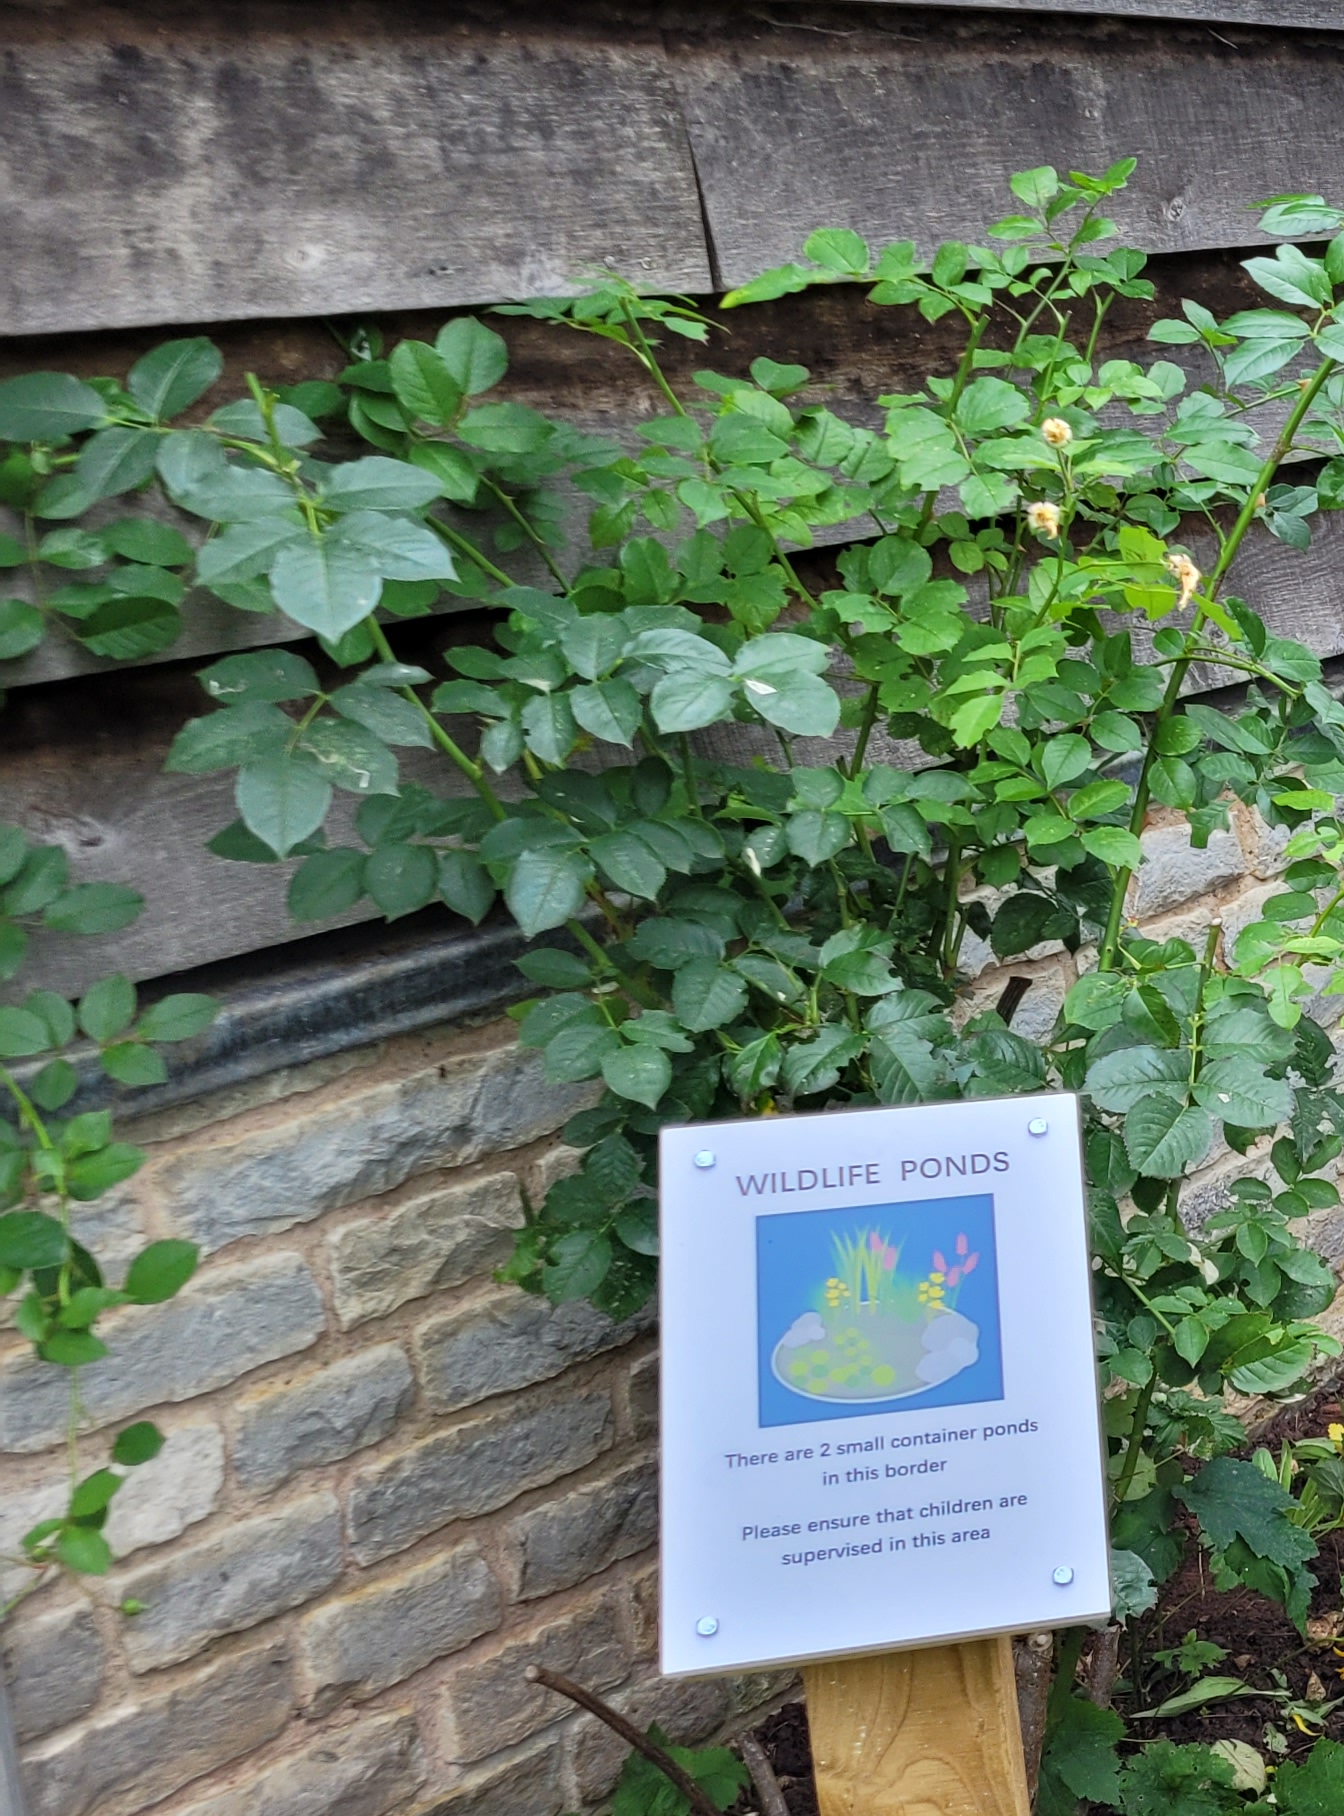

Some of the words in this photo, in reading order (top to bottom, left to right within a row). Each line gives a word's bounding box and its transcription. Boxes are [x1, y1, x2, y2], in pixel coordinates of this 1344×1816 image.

[735, 1162, 882, 1197] WILDLIFE
[900, 1151, 1010, 1182] PONDS
[723, 1452, 779, 1469] There
[784, 1447, 815, 1462] are
[819, 1442, 832, 1458] 2
[835, 1435, 885, 1456] small
[890, 1427, 979, 1449] container
[982, 1418, 1039, 1442] ponds
[822, 1471, 840, 1487] in
[844, 1465, 880, 1483] this
[884, 1458, 948, 1479] border
[741, 1523, 802, 1542] Please
[807, 1514, 871, 1533] ensure
[875, 1506, 915, 1524] that
[918, 1498, 994, 1519] children
[998, 1494, 1028, 1509] are
[780, 1537, 883, 1567] supervised
[888, 1536, 907, 1552] in
[911, 1530, 947, 1549] this
[950, 1527, 991, 1544] area
